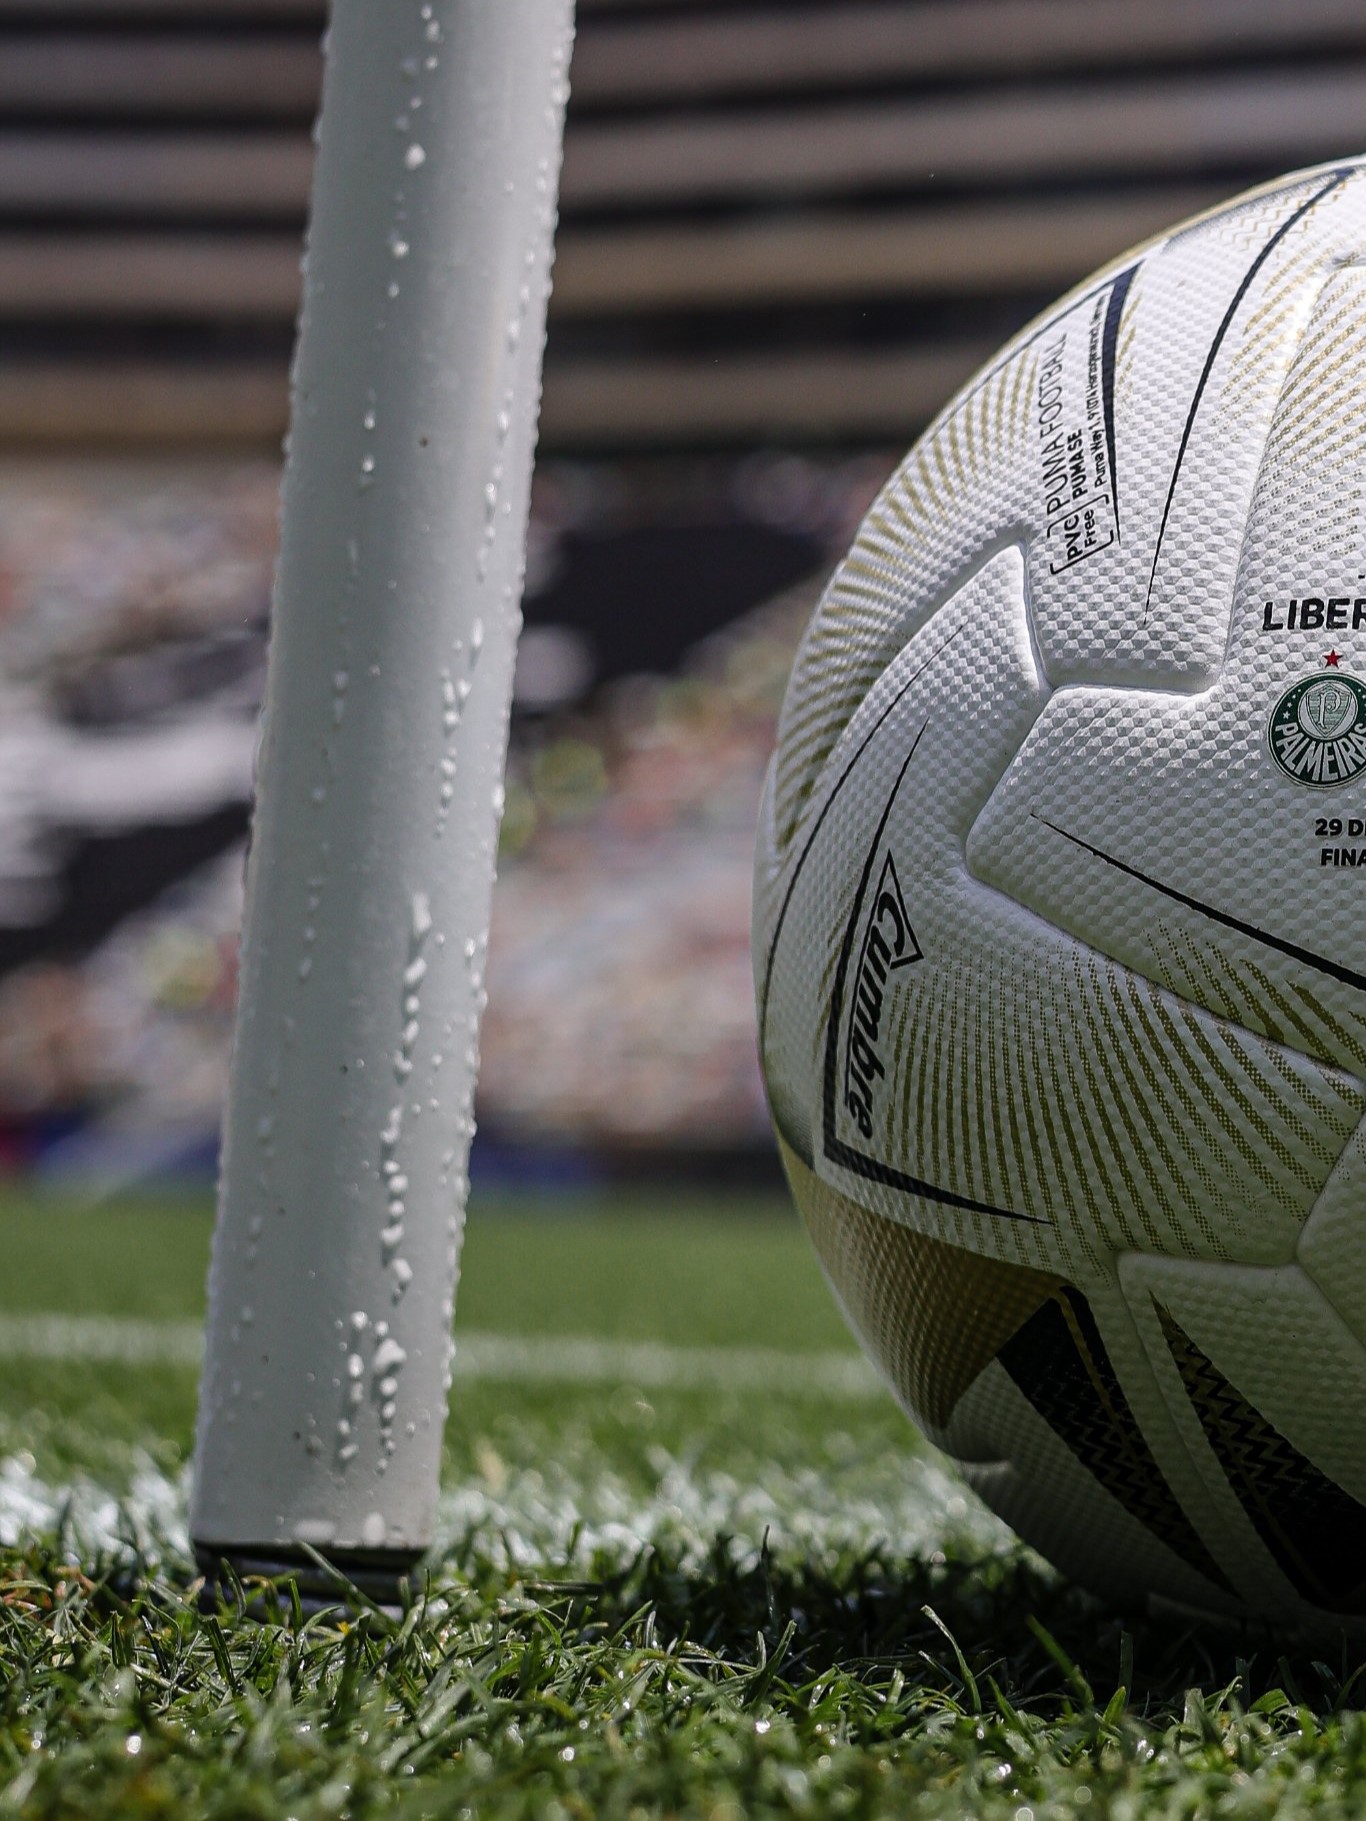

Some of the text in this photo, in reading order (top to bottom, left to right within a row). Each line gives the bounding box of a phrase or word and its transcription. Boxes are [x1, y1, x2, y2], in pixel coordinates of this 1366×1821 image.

[1039, 333, 1070, 515] PUMA FOOTBALL
[1090, 429, 1104, 455] Way
[1067, 428, 1088, 500] PUMA SE
[1094, 452, 1107, 488] Puma
[1064, 514, 1083, 561] PVC
[1084, 509, 1097, 548] Free
[1315, 818, 1343, 836] 29
[847, 891, 905, 1140] Cumbre
